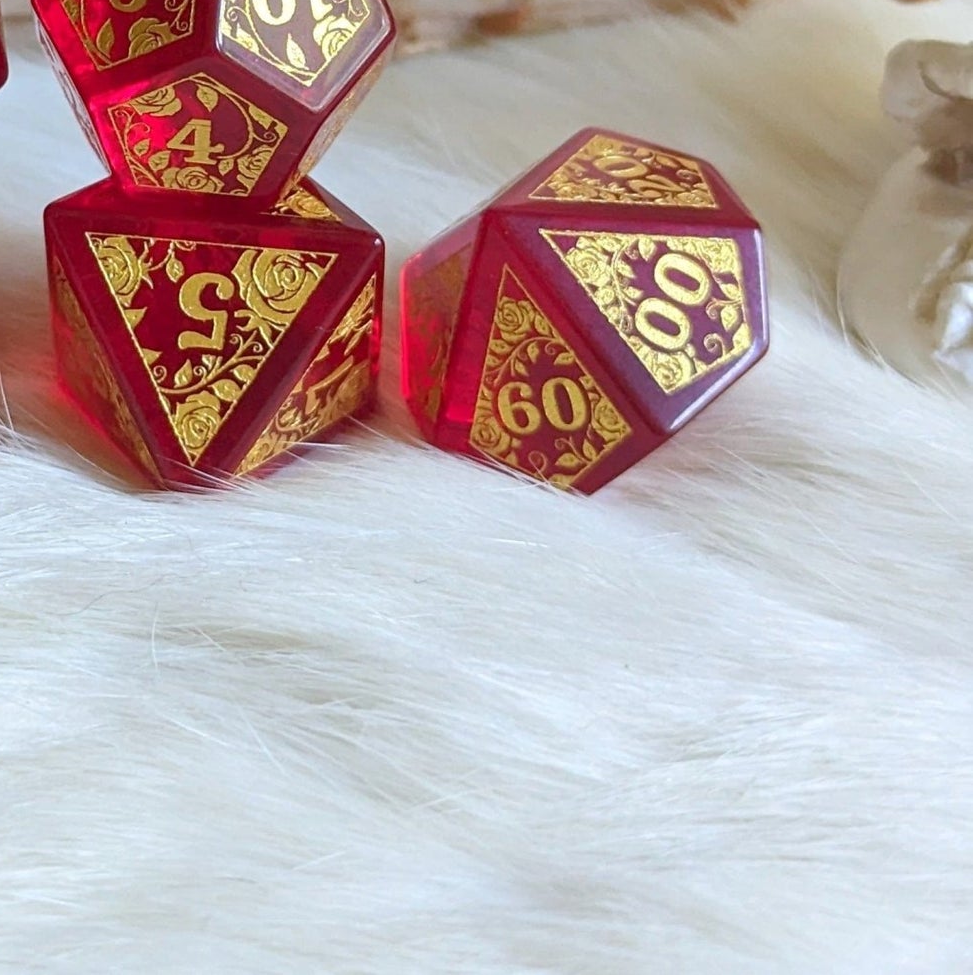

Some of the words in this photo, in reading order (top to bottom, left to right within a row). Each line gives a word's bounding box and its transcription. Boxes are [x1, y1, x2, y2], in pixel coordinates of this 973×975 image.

[166, 119, 225, 165] 4
[178, 272, 235, 351] 5
[635, 252, 714, 353] 00
[497, 377, 591, 435] 60
